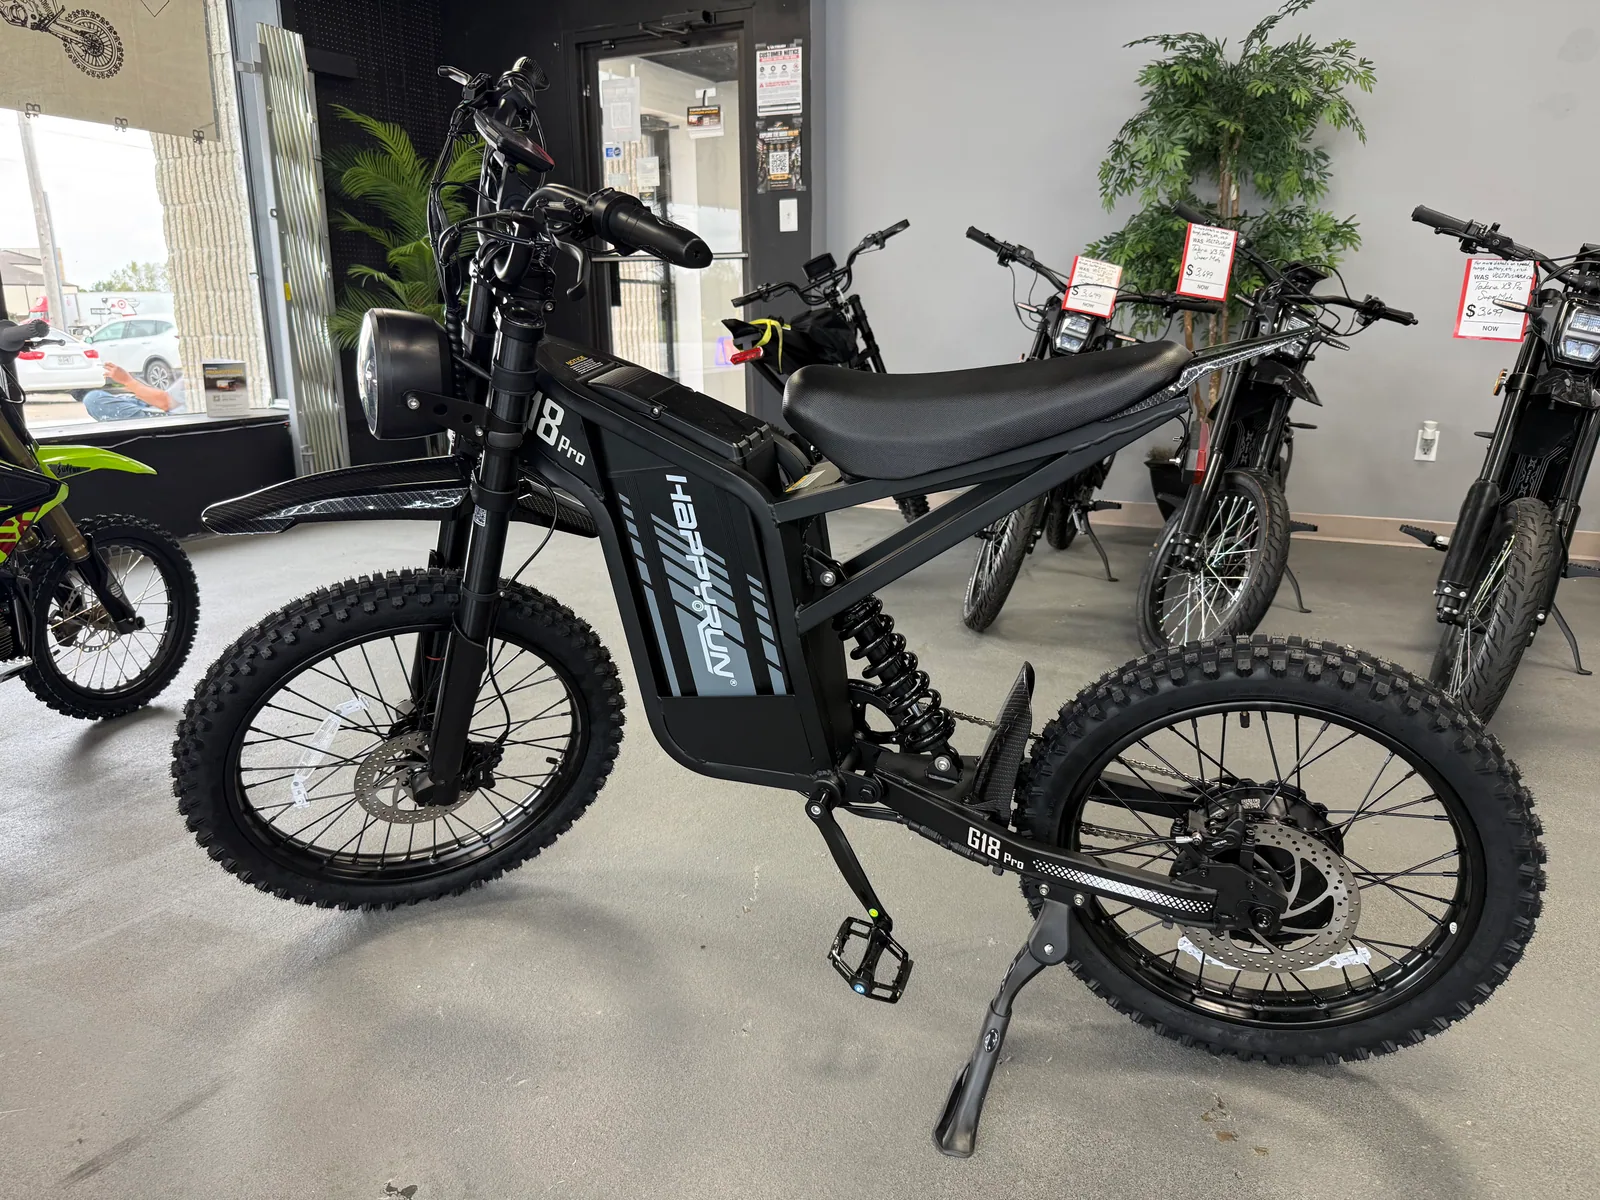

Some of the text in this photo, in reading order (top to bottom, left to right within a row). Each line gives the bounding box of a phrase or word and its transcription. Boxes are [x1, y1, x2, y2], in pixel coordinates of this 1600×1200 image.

[759, 50, 782, 58] CUSTOMER
[527, 390, 586, 466] 18 Pro
[967, 826, 1024, 870] G18 Pro
